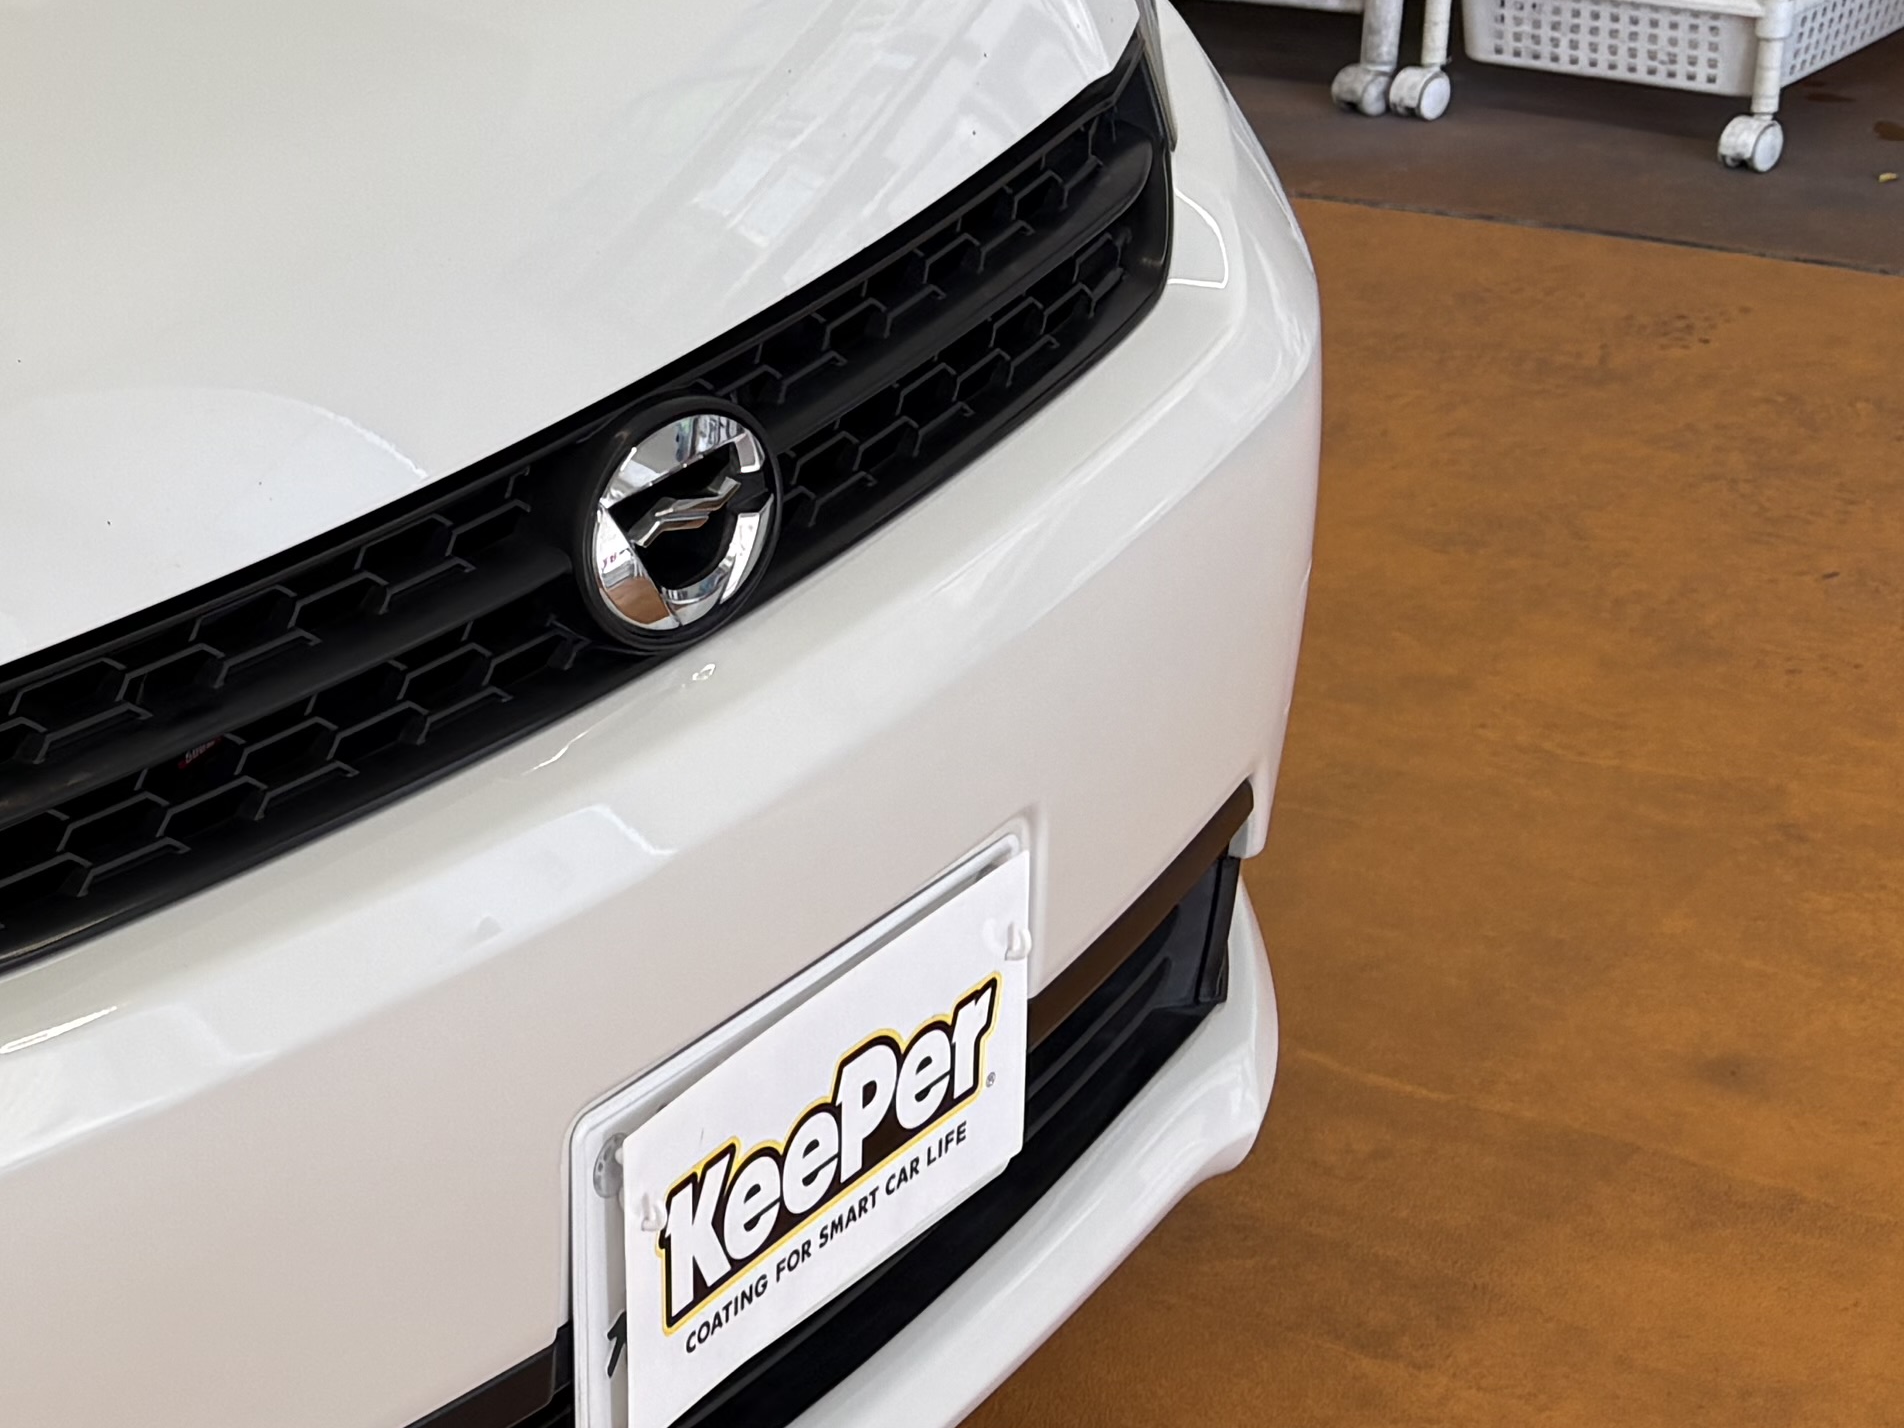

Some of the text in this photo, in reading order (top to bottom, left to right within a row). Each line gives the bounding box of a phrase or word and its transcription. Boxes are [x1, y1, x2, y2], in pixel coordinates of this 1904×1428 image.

[657, 974, 1000, 1334] KeePer
[685, 1273, 769, 1354] COATING
[775, 1239, 813, 1283] FOR
[818, 1187, 881, 1250] SMART
[884, 1156, 921, 1197] CAR
[926, 1120, 968, 1168] LIFE
